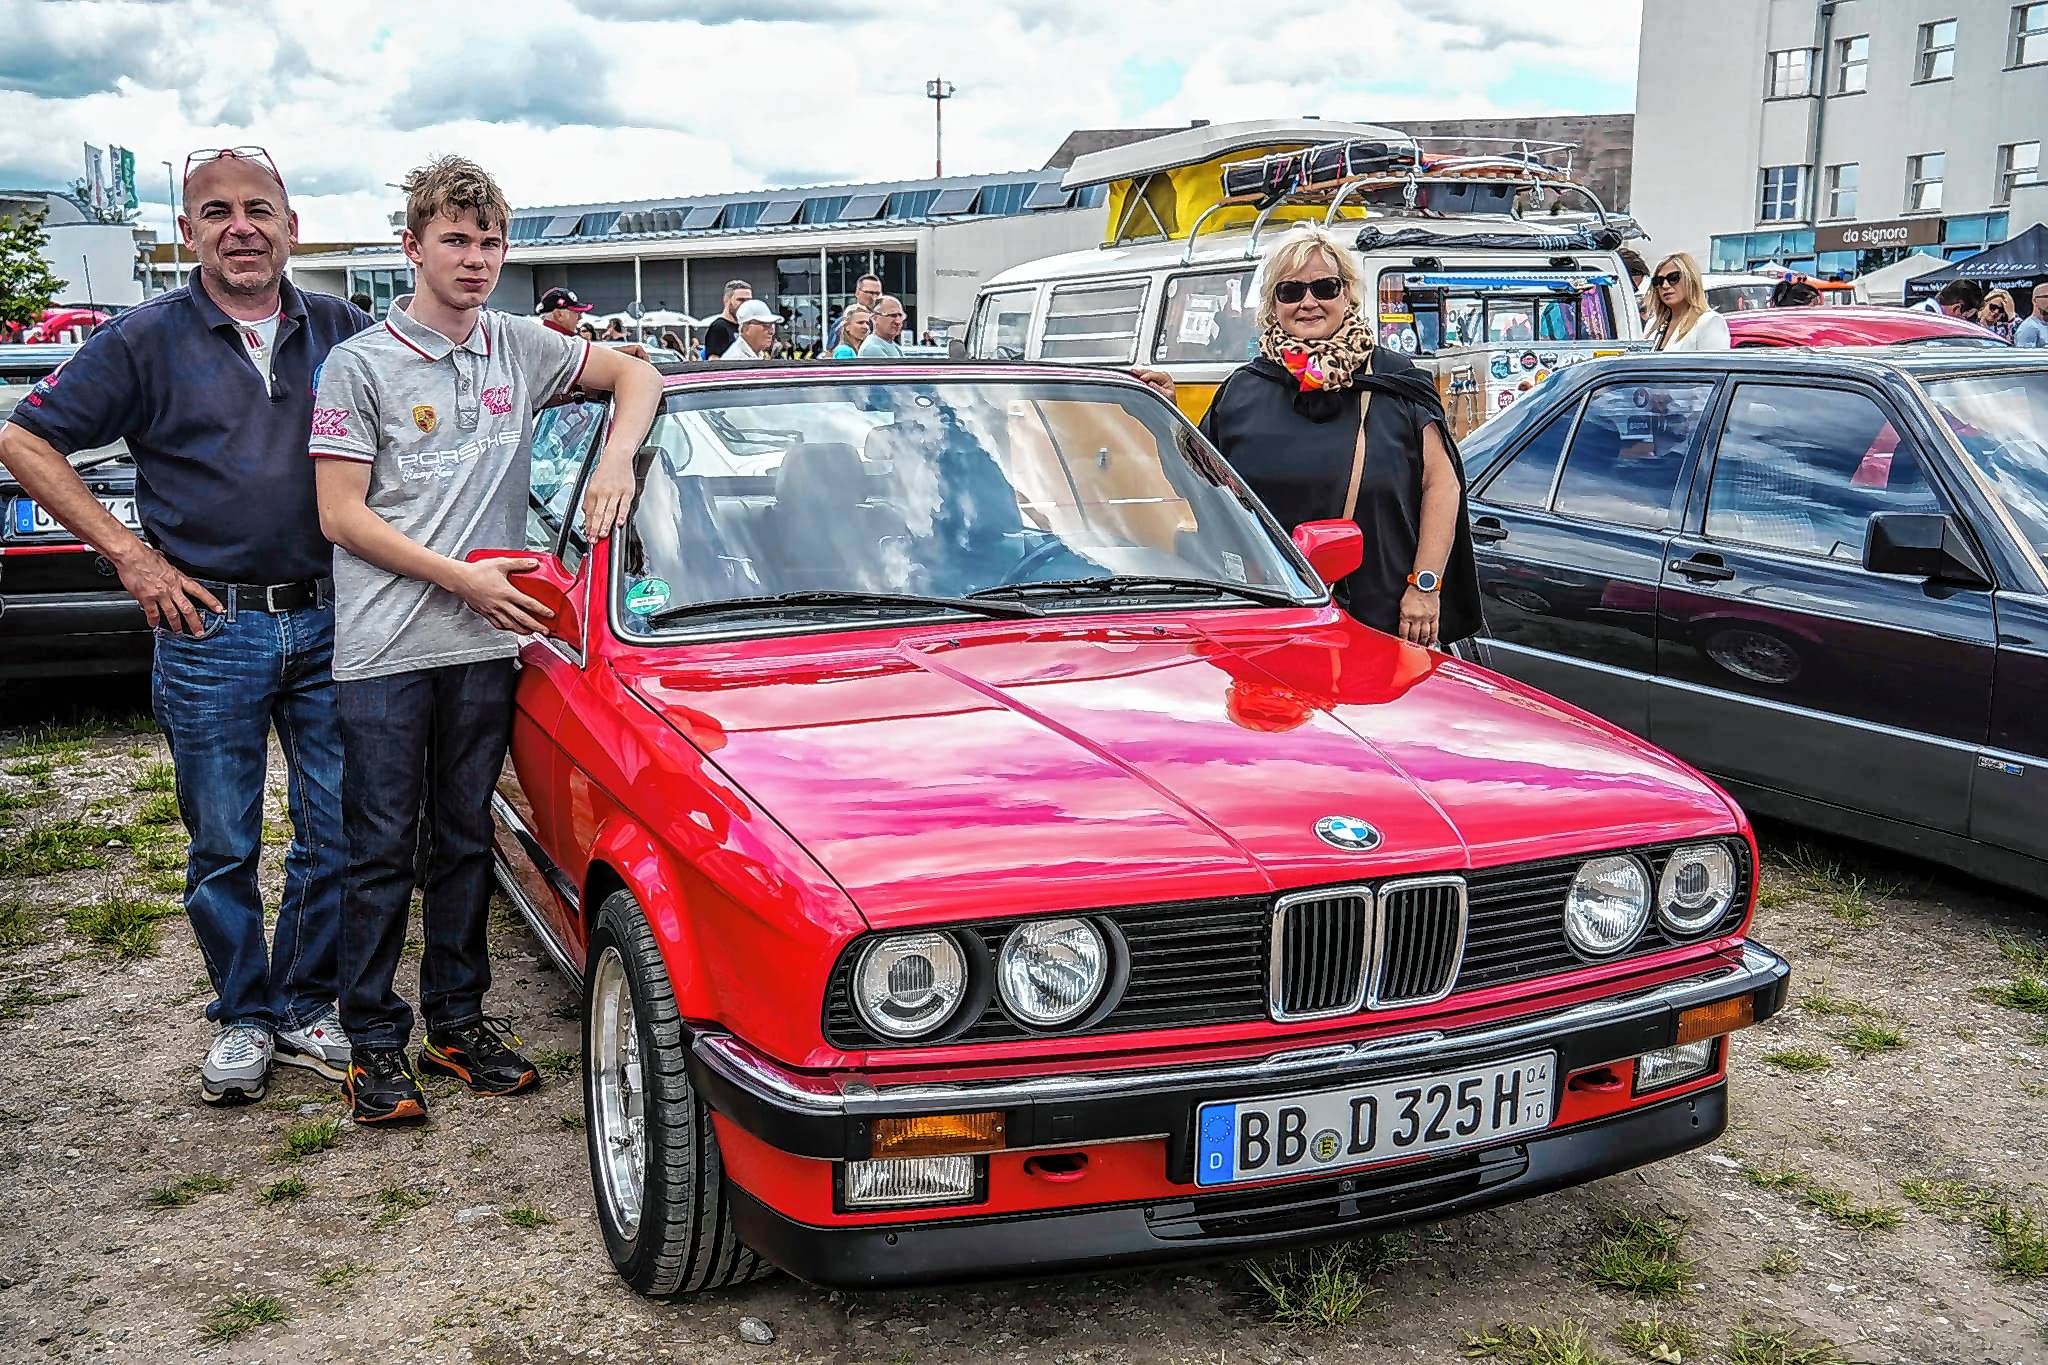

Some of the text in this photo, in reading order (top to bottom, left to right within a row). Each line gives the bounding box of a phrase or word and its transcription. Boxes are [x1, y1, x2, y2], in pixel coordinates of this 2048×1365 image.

[1843, 228, 1859, 243] da
[1861, 225, 1908, 244] signora
[397, 430, 521, 471] PORSCHE
[642, 580, 656, 595] 4
[1525, 1102, 1545, 1121] 10
[1239, 1105, 1307, 1171] BB
[1347, 1094, 1378, 1155] D
[1209, 1152, 1222, 1169] D
